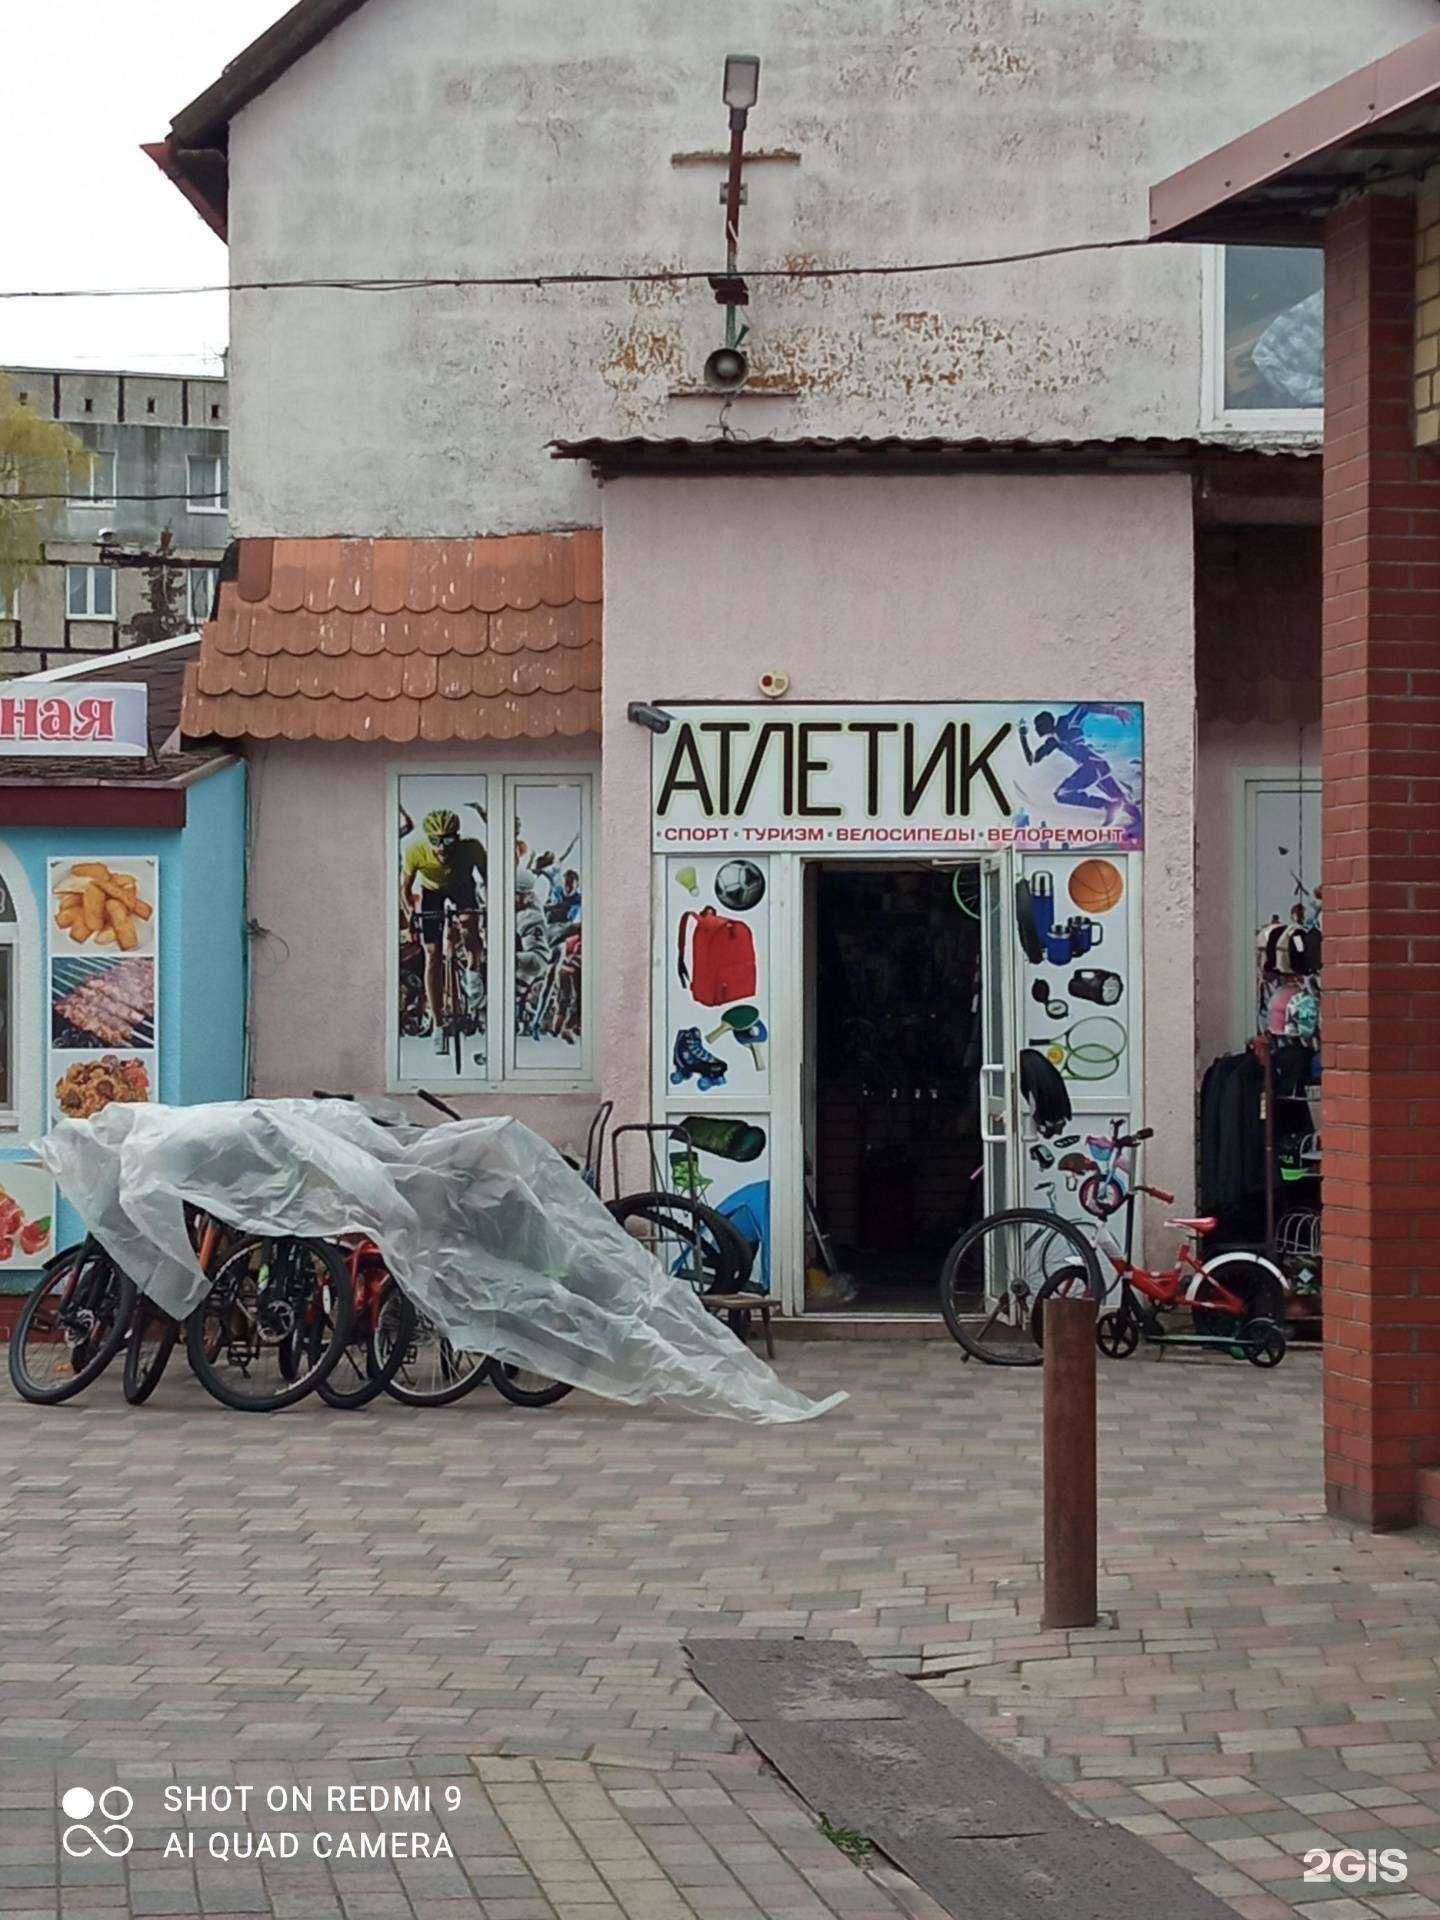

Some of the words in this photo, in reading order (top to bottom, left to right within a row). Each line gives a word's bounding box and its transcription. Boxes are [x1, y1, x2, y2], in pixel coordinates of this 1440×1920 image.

[656, 721, 1012, 817] АТЛЕТИК
[664, 827, 729, 842] СПОРТ
[742, 827, 825, 842] ТУРИЗМ
[836, 827, 976, 843] ВЕЛОСИПЕДЫ
[987, 827, 1124, 843] ВЕЛОРЕМОНТ
